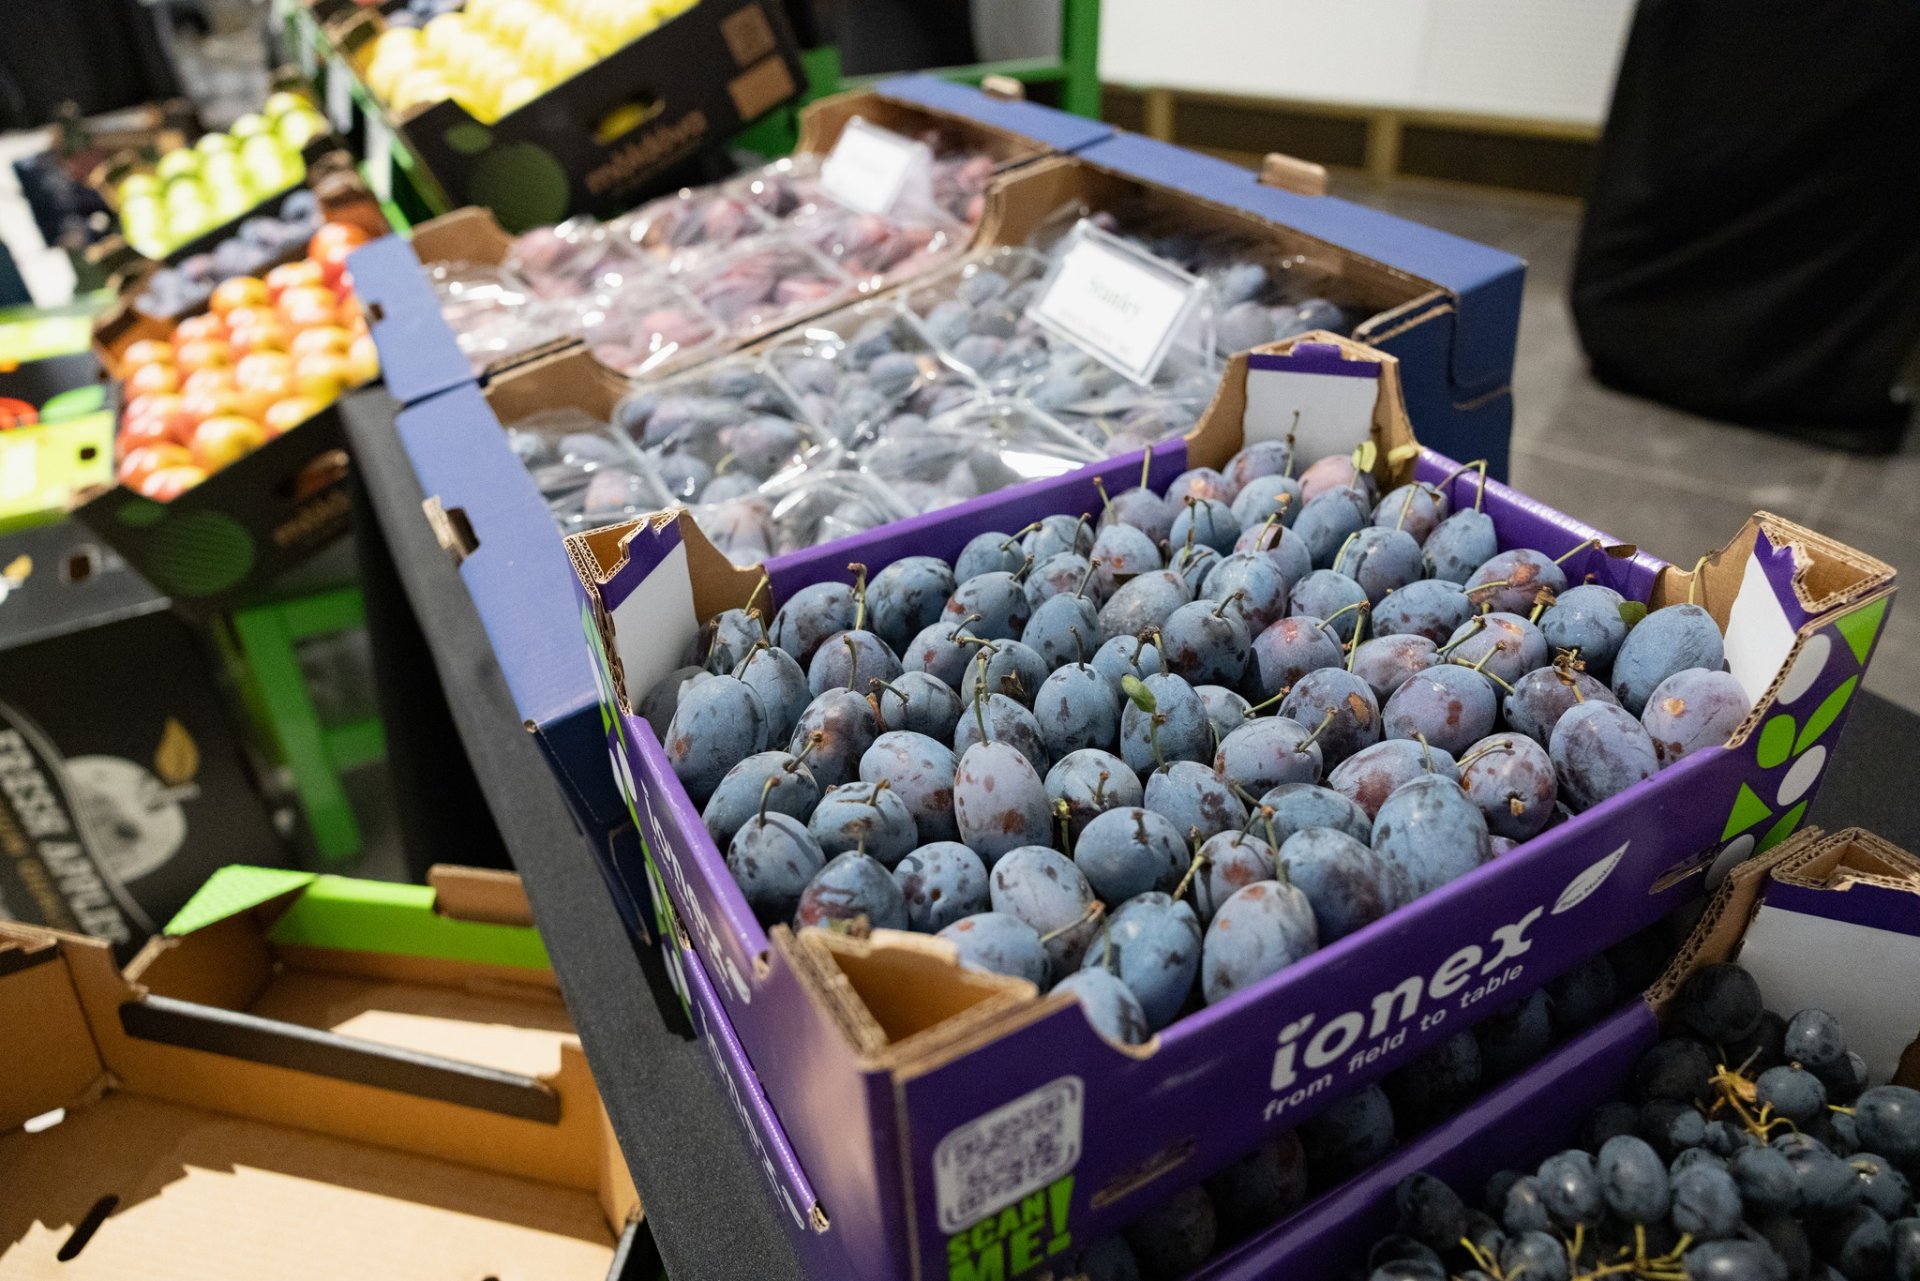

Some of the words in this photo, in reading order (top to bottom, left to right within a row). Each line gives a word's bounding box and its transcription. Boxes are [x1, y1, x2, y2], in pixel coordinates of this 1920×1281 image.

[1263, 1073, 1333, 1121] from
[1348, 1027, 1406, 1074] field
[1419, 1009, 1447, 1032] to
[1459, 964, 1524, 1009] table
[1269, 905, 1545, 1091] ionex
[947, 1188, 1046, 1266] SCAN
[949, 1174, 1075, 1281] ME!
